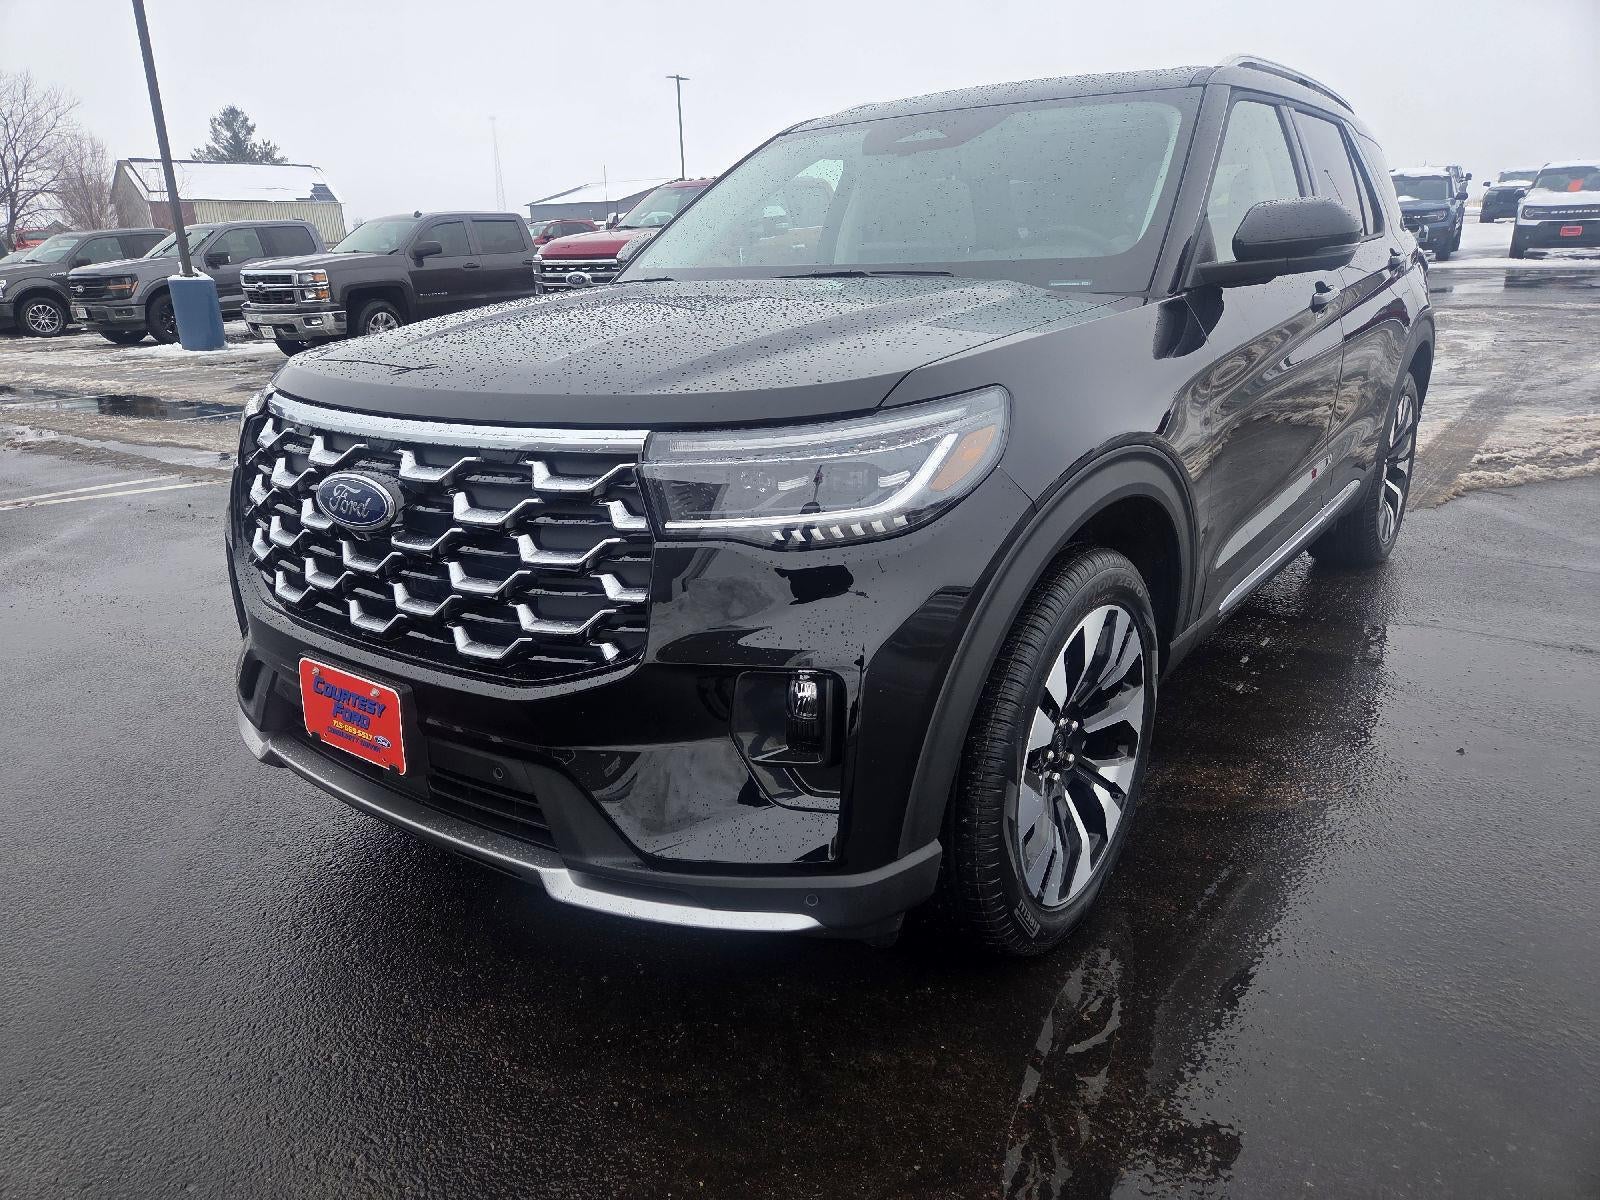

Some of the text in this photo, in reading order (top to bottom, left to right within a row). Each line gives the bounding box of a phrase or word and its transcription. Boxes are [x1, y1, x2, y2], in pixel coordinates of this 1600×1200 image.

[328, 484, 372, 518] Ford
[313, 675, 386, 718] COURTESY
[332, 701, 370, 730] FORD
